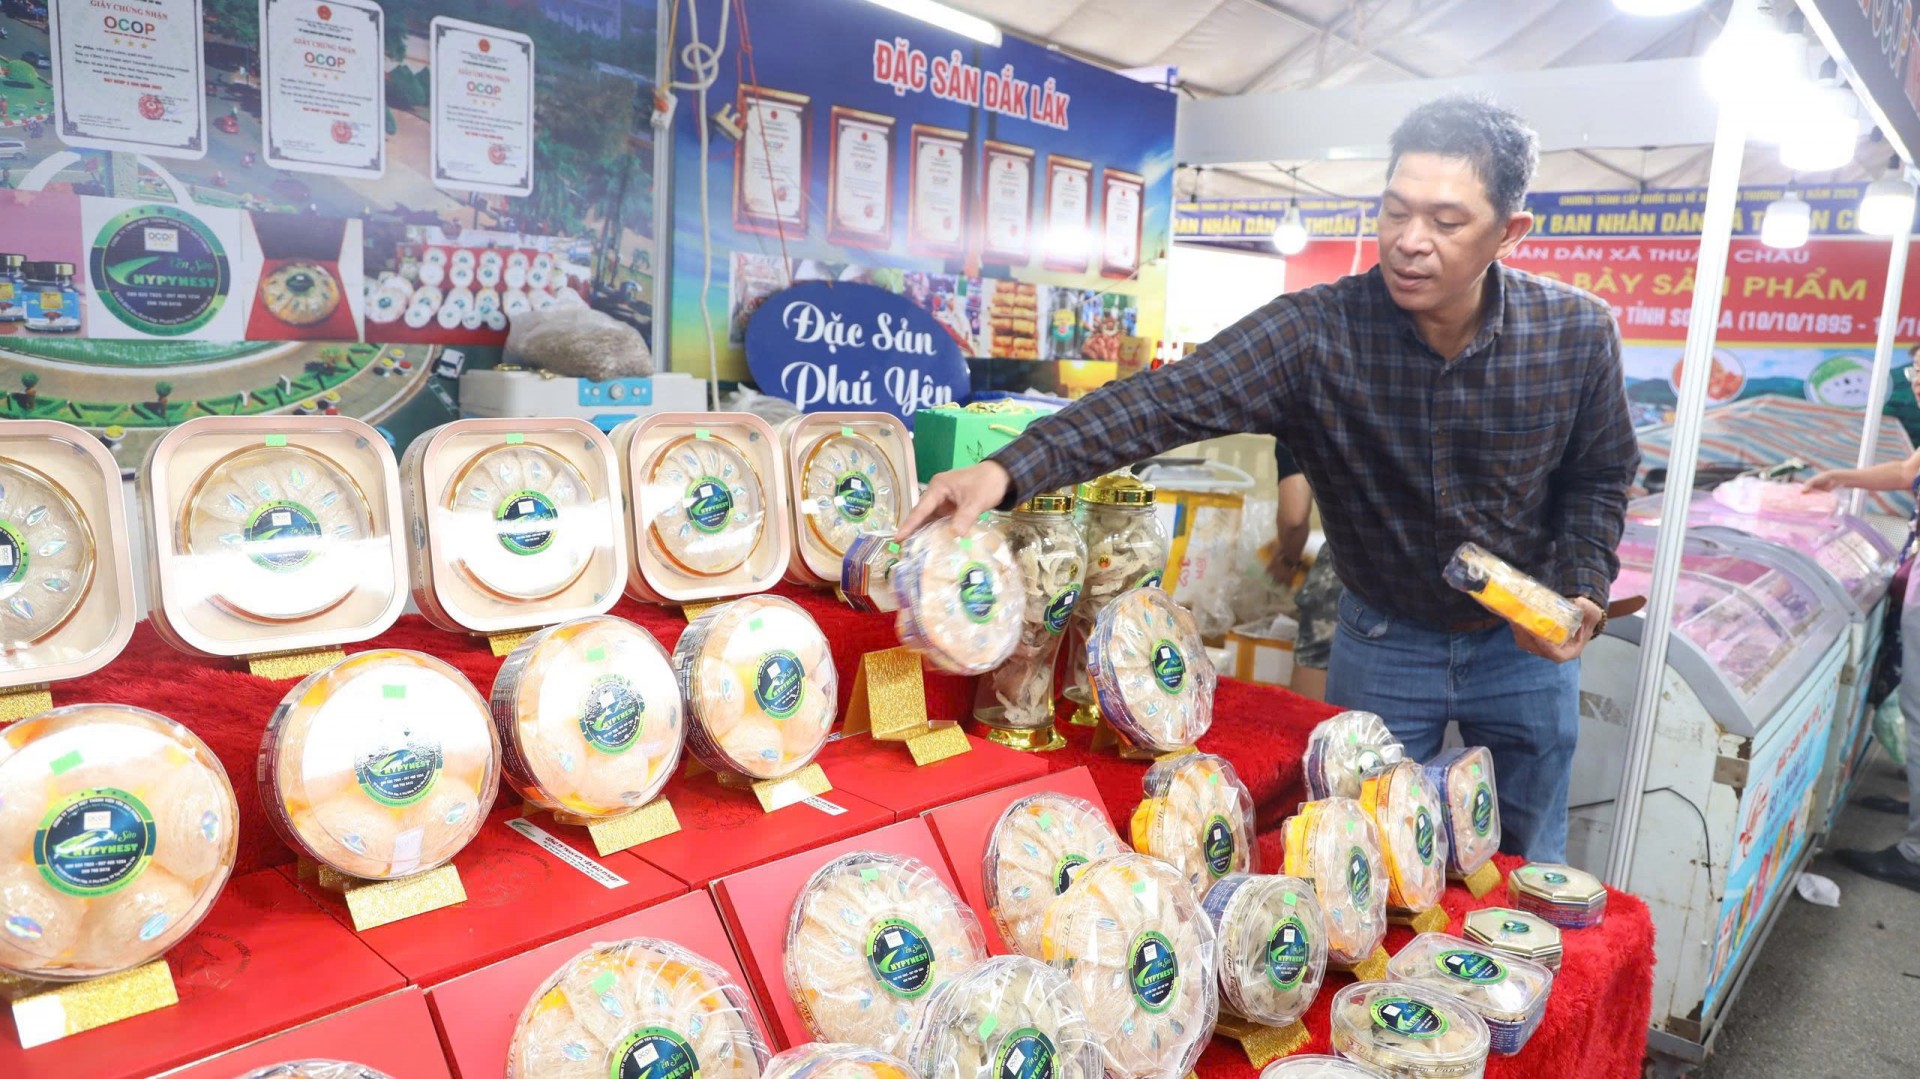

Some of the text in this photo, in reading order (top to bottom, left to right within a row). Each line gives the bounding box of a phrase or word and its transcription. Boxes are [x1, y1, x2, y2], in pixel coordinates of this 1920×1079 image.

[104, 15, 156, 35] OCOP
[304, 51, 346, 68] OCOP
[467, 81, 502, 96] OCOP
[874, 38, 1070, 129] ĐẶC SẢN ĐẮK LẮK
[1202, 214, 1242, 235] NHÂN
[1244, 214, 1276, 235] DÂN
[1551, 213, 1592, 233] BAN
[1596, 209, 1656, 233] NHÂN
[1660, 208, 1705, 232] DÂN
[1513, 244, 1549, 260] HÂN
[1554, 244, 1603, 261] DÂN
[1610, 245, 1642, 261] XÃ
[1734, 249, 1810, 264] CHÂU
[1573, 267, 1643, 295] BÀY
[1743, 267, 1867, 300] PHẨM
[782, 301, 937, 356] Đặc Sản
[1626, 300, 1666, 326] TỈNH
[1738, 310, 1853, 335] (10/10/1895
[781, 361, 952, 416] Phú Yên
